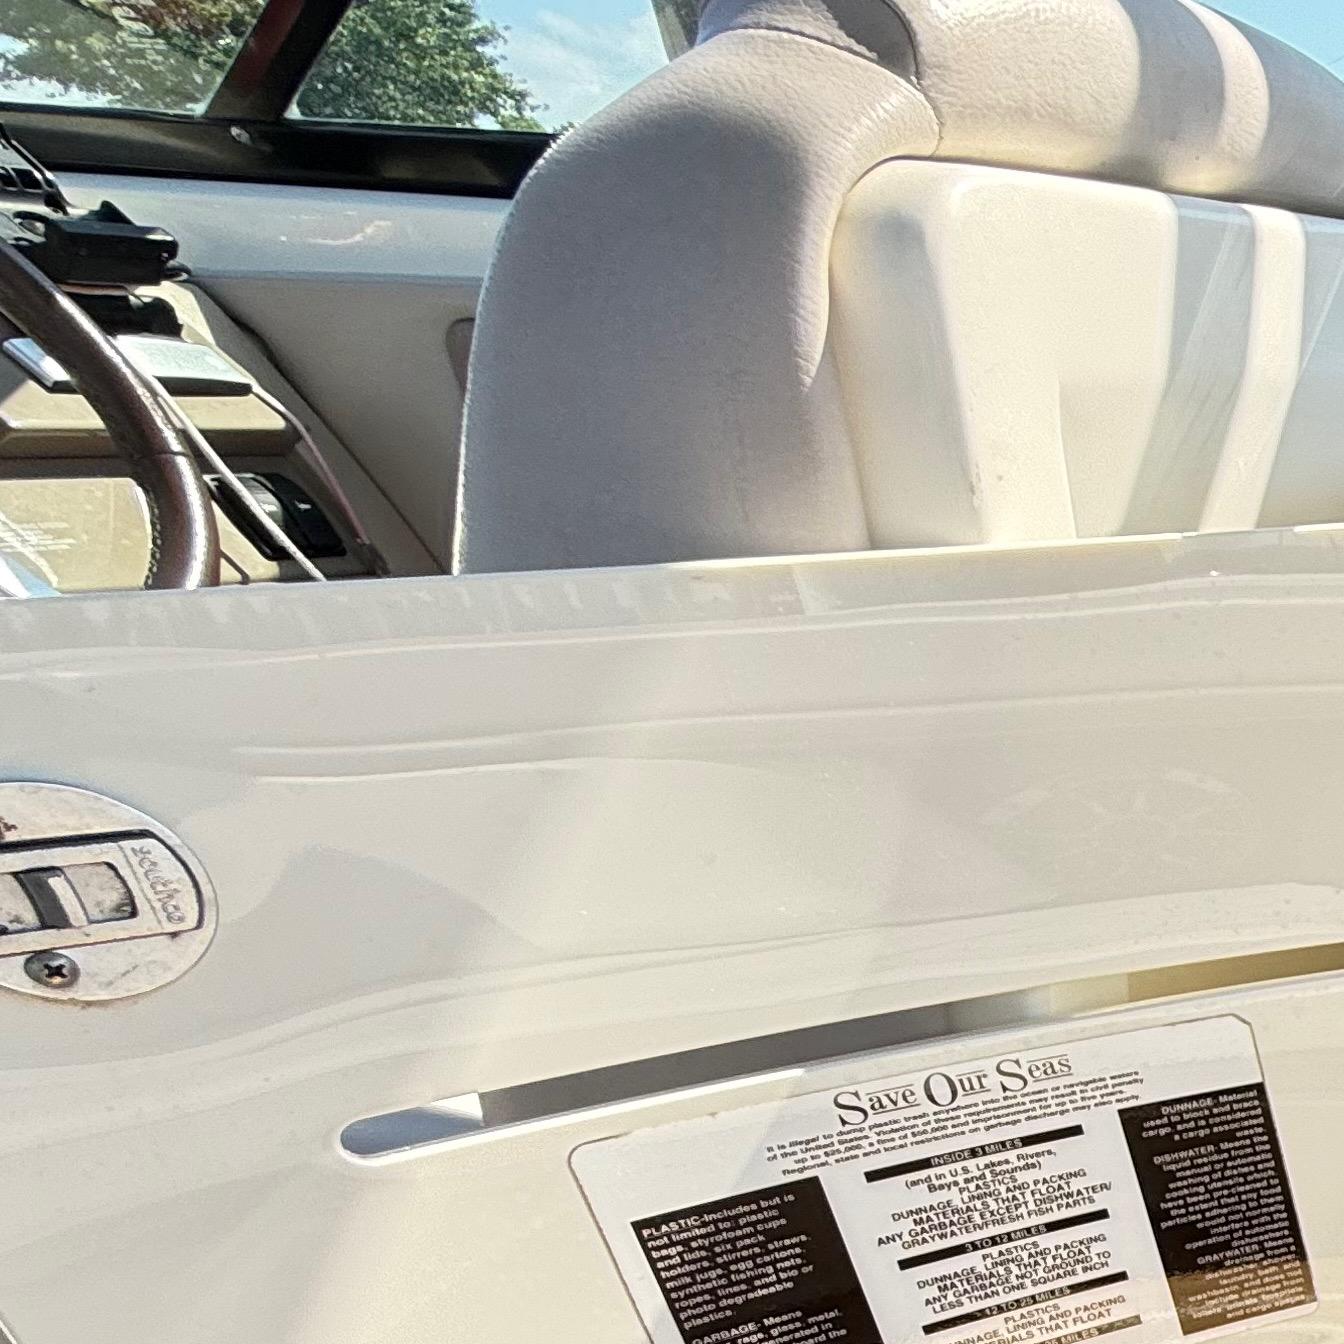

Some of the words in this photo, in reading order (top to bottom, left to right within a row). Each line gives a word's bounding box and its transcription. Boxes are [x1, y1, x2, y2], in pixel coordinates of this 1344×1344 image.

[833, 1084, 919, 1126] Save
[923, 1070, 990, 1107] Our
[995, 1054, 1072, 1093] Seas
[904, 1174, 933, 1189] (and
[933, 1172, 947, 1181] in
[948, 1165, 973, 1178] U.S.
[975, 1158, 1013, 1171] Lakes,
[1015, 1148, 1056, 1162] Rivers,
[930, 1149, 971, 1165] INSIDE
[974, 1147, 983, 1156] 3
[984, 1138, 1022, 1153] MILES
[926, 1179, 960, 1193] Bays
[962, 1171, 987, 1184] and
[988, 1159, 1041, 1180] Sounds)
[957, 1174, 1018, 1195] PLASTICS
[960, 1187, 1001, 1204] LINING
[1005, 1180, 1030, 1194] AND
[1032, 1168, 1086, 1187] PACKING
[759, 1195, 781, 1208] but
[782, 1193, 795, 1202] is
[877, 1231, 903, 1247] ANY
[908, 1214, 974, 1238] GARBAGE
[978, 1200, 1029, 1220] EXCEPT
[1033, 1182, 1111, 1207] DISHWATER/
[912, 1200, 990, 1226] MATERIALS
[992, 1191, 1026, 1207] THAT
[1029, 1180, 1071, 1198] FLOAT
[646, 1235, 670, 1248] not
[670, 1223, 715, 1241] limited
[737, 1209, 779, 1225] plastic
[901, 1212, 1024, 1249] GRAYWATER/FRESH
[1026, 1204, 1054, 1218] FISH
[1055, 1195, 1095, 1211] PARTS
[964, 1242, 973, 1252] 3
[974, 1238, 992, 1248] TO
[994, 1233, 1008, 1243] 12
[1010, 1224, 1046, 1239] MILES
[936, 1266, 1012, 1293] MATERIALS
[1015, 1256, 1047, 1272] THAT
[1051, 1244, 1091, 1262] FLOAT
[981, 1240, 1039, 1262] PLASTICS
[983, 1254, 1024, 1271] LINING
[1027, 1247, 1051, 1260] AND
[1053, 1233, 1106, 1252] PACKING
[924, 1292, 948, 1307] ANY
[952, 1275, 1012, 1298] GARBAGE
[1014, 1268, 1038, 1281] NOT
[1042, 1255, 1093, 1274] GROUND
[1094, 1250, 1111, 1260] TO
[931, 1298, 964, 1314] LESS
[965, 1288, 1000, 1303] THAN
[1001, 1281, 1027, 1294] ONE
[1030, 1267, 1078, 1287] SQUARE
[1080, 1260, 1109, 1273] INCH
[984, 1305, 998, 1315] 12
[1000, 1300, 1017, 1311] TO
[1019, 1296, 1033, 1307] 25
[1034, 1286, 1070, 1301] MILES
[1003, 1302, 1060, 1324] PLASTICS
[1005, 1317, 1045, 1334] LINING
[1048, 1309, 1072, 1322] AND
[1074, 1294, 1126, 1314] PACKING
[1036, 1319, 1068, 1335] THAT
[1071, 1307, 1111, 1326] FLOAT
[1060, 1327, 1098, 1344] MILES
